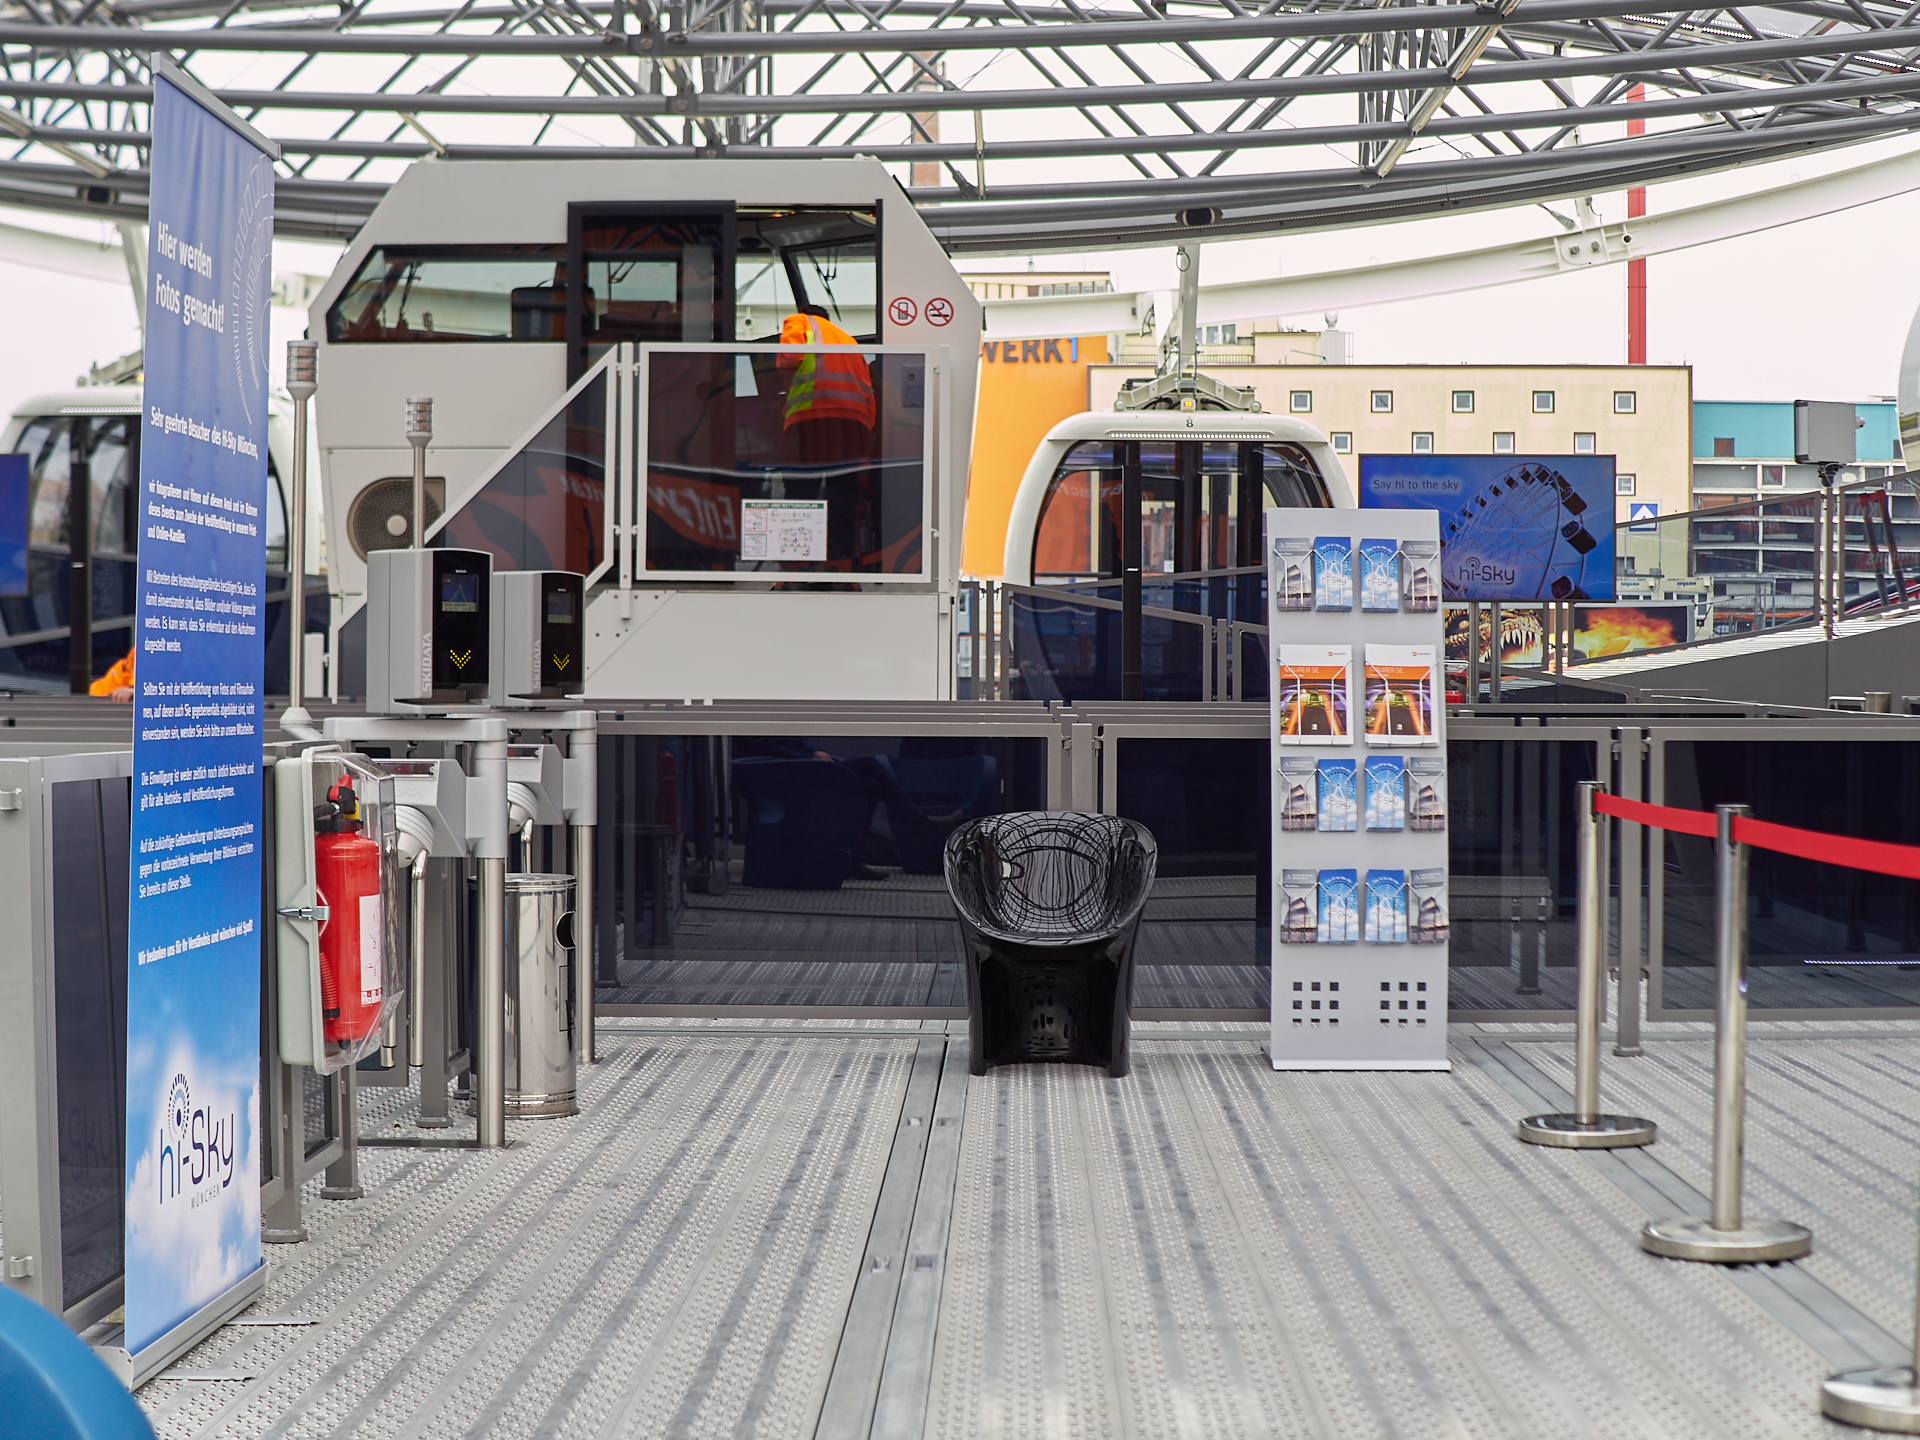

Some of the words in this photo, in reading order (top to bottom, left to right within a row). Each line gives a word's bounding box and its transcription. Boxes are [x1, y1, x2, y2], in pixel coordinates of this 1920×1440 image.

[158, 221, 177, 260] Hier
[180, 241, 212, 279] werden
[156, 273, 180, 314] Fotos
[183, 294, 224, 333] gemacht!
[151, 406, 164, 428] Sehr
[164, 413, 187, 434] geehrte
[188, 418, 210, 442] Besucher
[211, 426, 221, 446] des
[1186, 419, 1193, 428] 8
[1373, 480, 1391, 491] Say
[1395, 480, 1404, 489] hi
[1408, 481, 1418, 489] to
[1422, 480, 1438, 489] the
[1442, 480, 1459, 491] sky
[1460, 565, 1515, 585] hi-Sky
[422, 632, 432, 692] SKIDATA
[533, 639, 542, 689] SKIDATA
[160, 1106, 234, 1204] hi-Sky
[191, 1184, 220, 1210] MÜNCHEN
